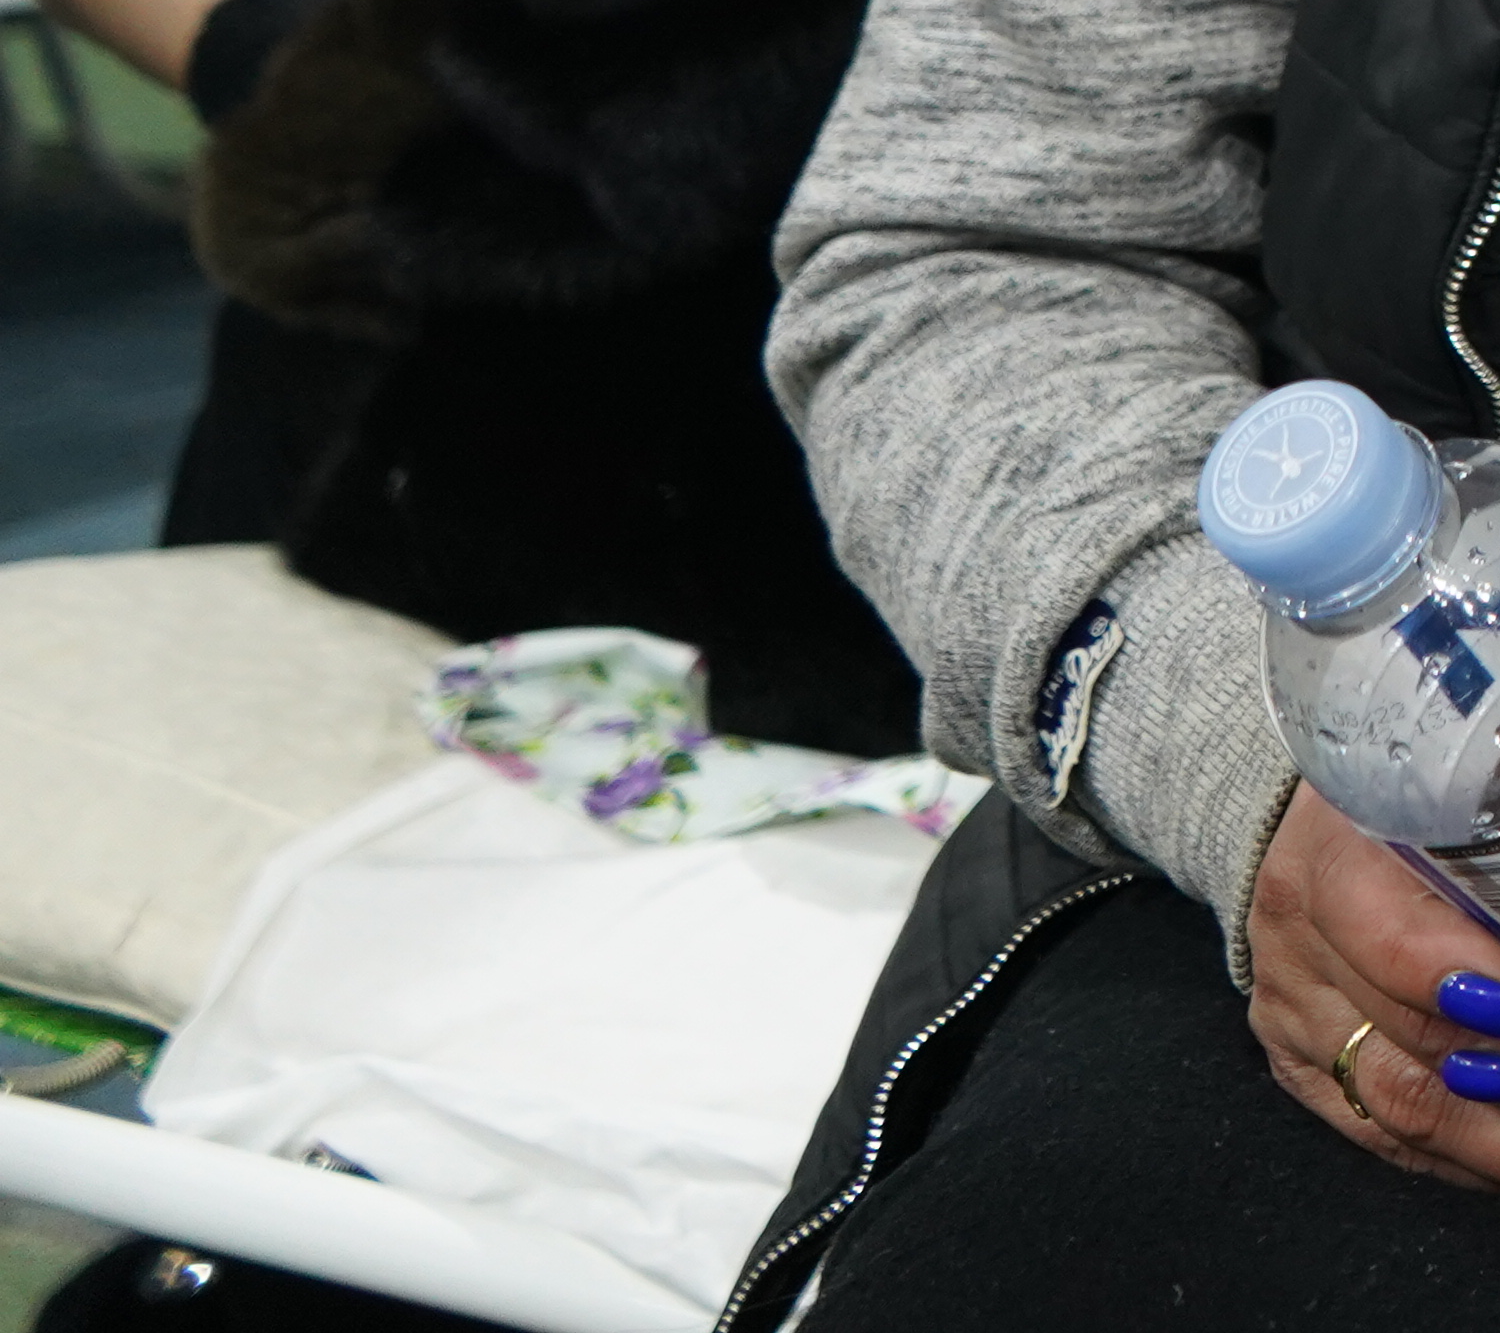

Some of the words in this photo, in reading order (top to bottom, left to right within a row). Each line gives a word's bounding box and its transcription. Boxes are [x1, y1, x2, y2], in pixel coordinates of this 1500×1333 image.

[1263, 397, 1342, 424] LIFESTYLE
[1222, 424, 1260, 479] ACTIVE
[1320, 435, 1351, 490] PURE
[1221, 486, 1239, 515] FOR
[1250, 491, 1321, 527] WATER
